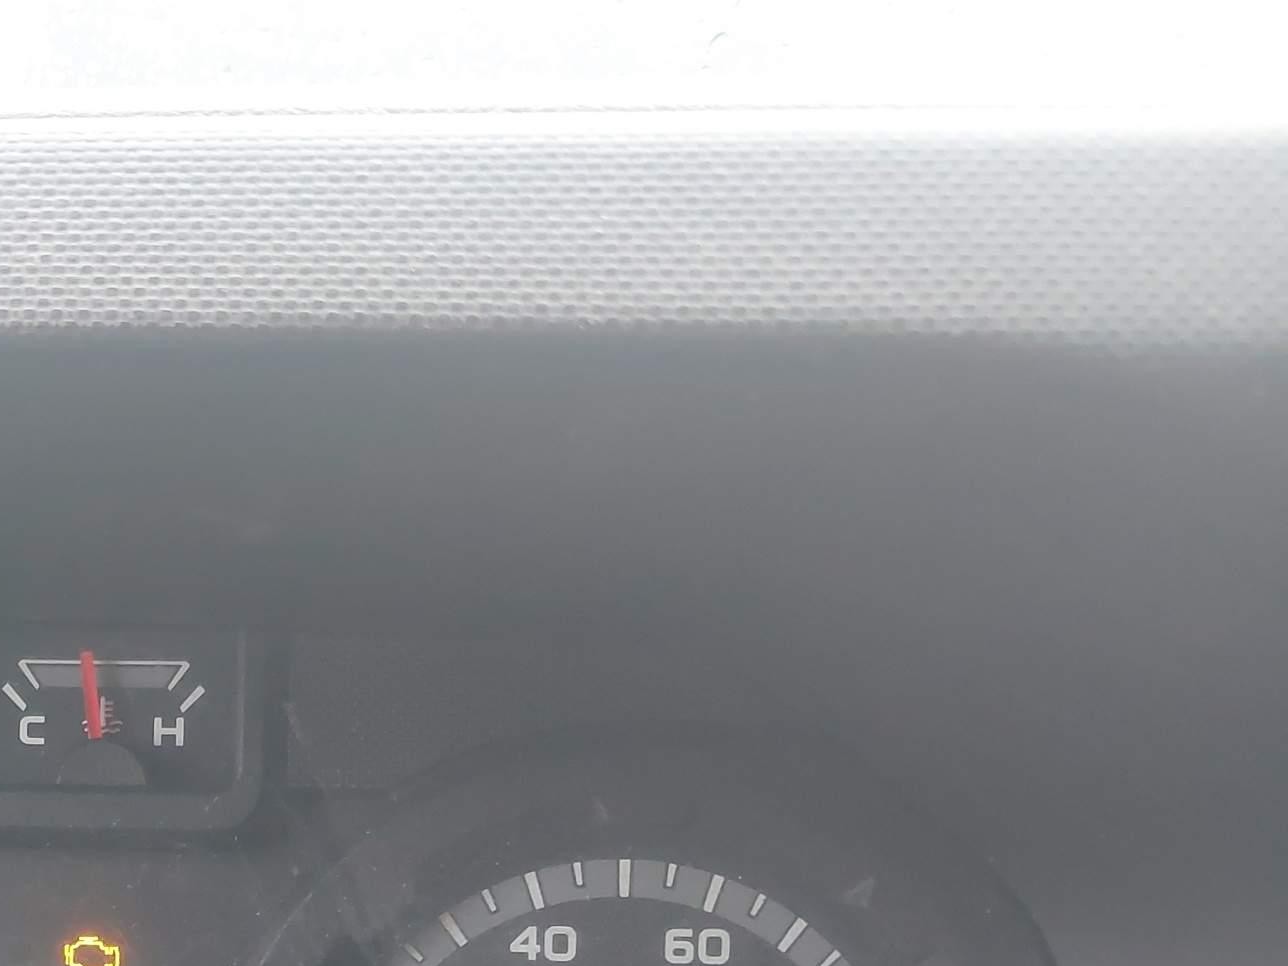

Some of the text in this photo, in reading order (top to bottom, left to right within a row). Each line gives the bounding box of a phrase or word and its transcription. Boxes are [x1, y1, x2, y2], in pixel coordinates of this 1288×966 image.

[19, 715, 46, 745] C
[153, 716, 185, 747] H
[509, 925, 578, 962] 40
[664, 928, 731, 965] 60
